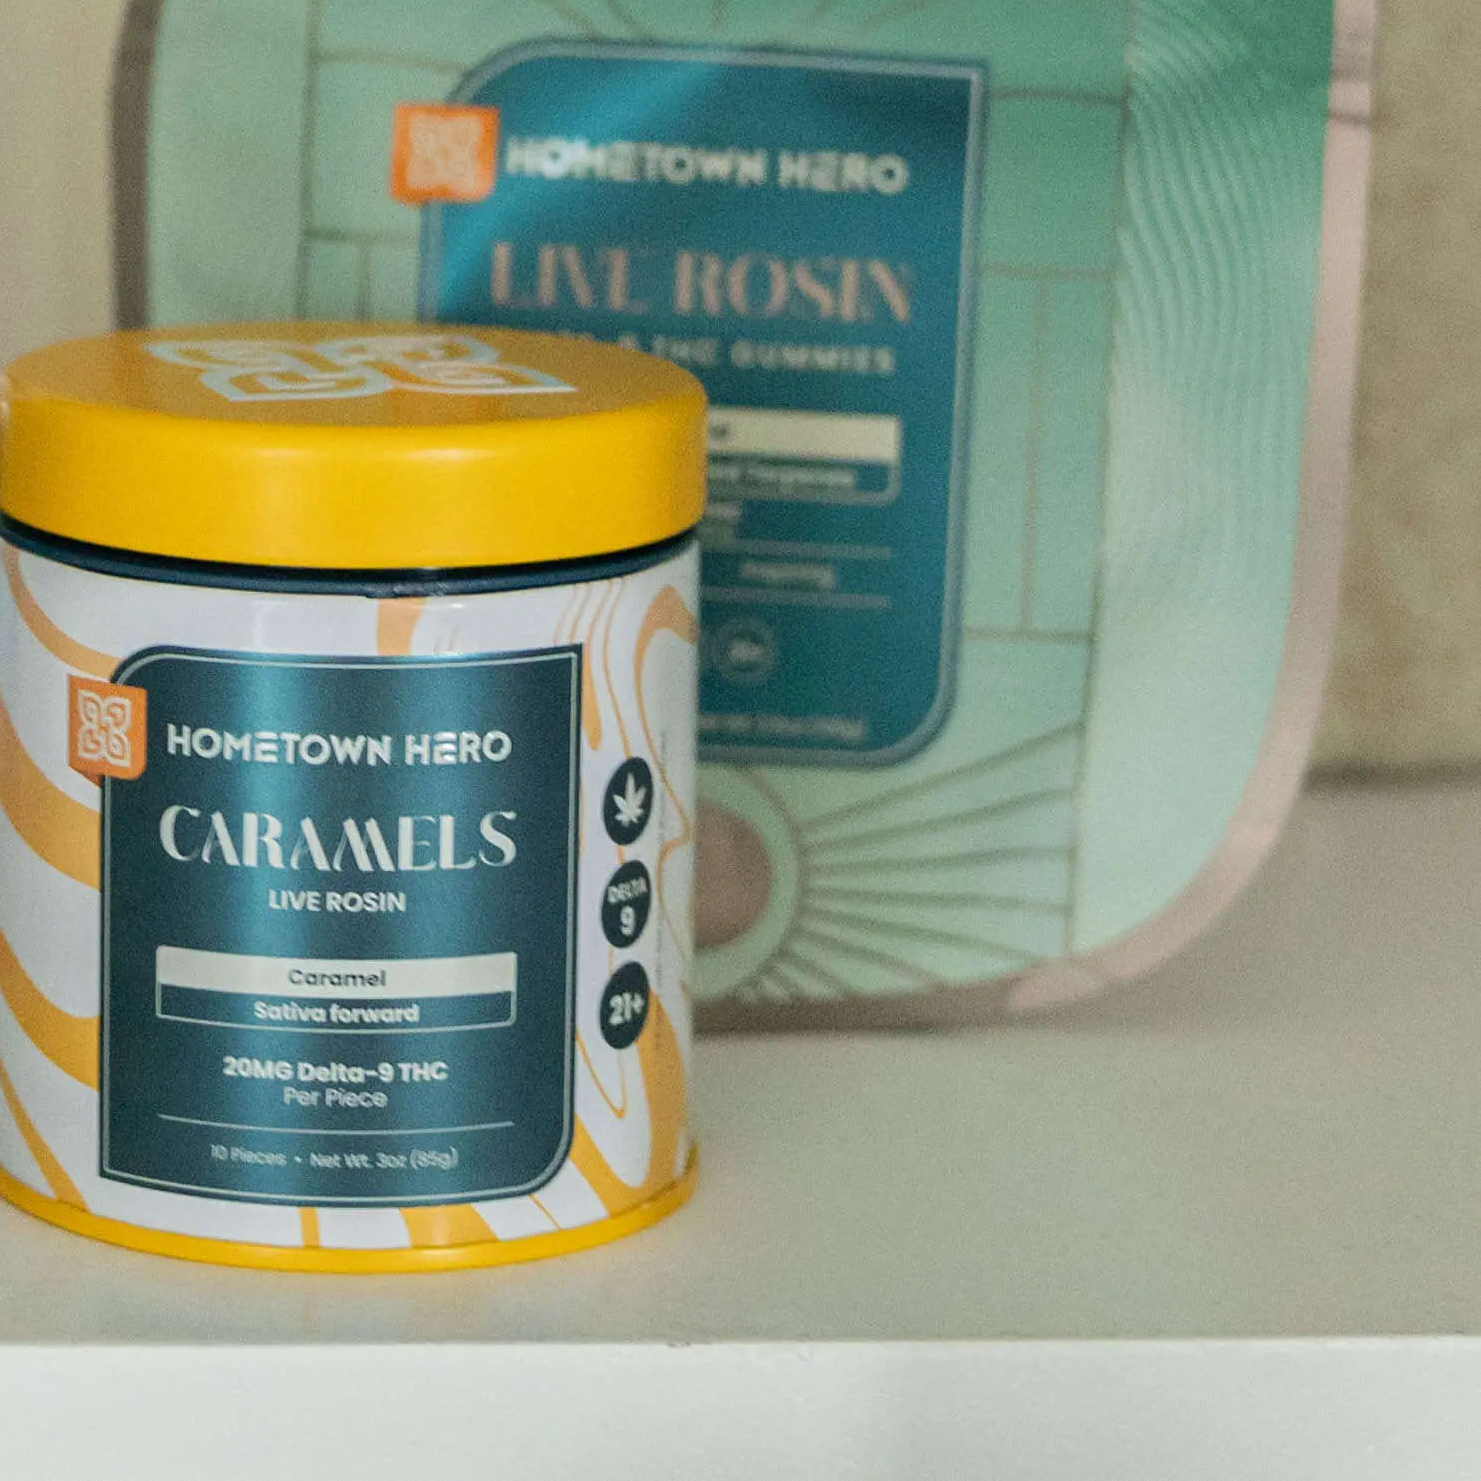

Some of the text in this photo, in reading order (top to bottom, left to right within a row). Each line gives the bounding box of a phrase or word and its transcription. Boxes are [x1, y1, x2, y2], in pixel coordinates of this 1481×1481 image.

[504, 136, 910, 196] HOMETOWN HERO
[490, 241, 912, 323] LIVE ROSIN
[730, 338, 896, 374] GUMMIES
[167, 723, 513, 767] HOMETOWN HERO
[159, 804, 518, 872] CARAMELS
[268, 890, 407, 913] LIVE ROSIN
[620, 905, 636, 937] 9
[287, 968, 387, 989] Caramel
[254, 1001, 421, 1024] Sativa forward
[608, 991, 645, 1026] 21+
[222, 1056, 449, 1084] 20MG Delta-9 THC
[283, 1086, 389, 1109] Per Piece
[210, 1143, 229, 1161] 10
[230, 1146, 288, 1167] Pieces
[309, 1152, 342, 1169] Net
[376, 1151, 408, 1169] 3oz
